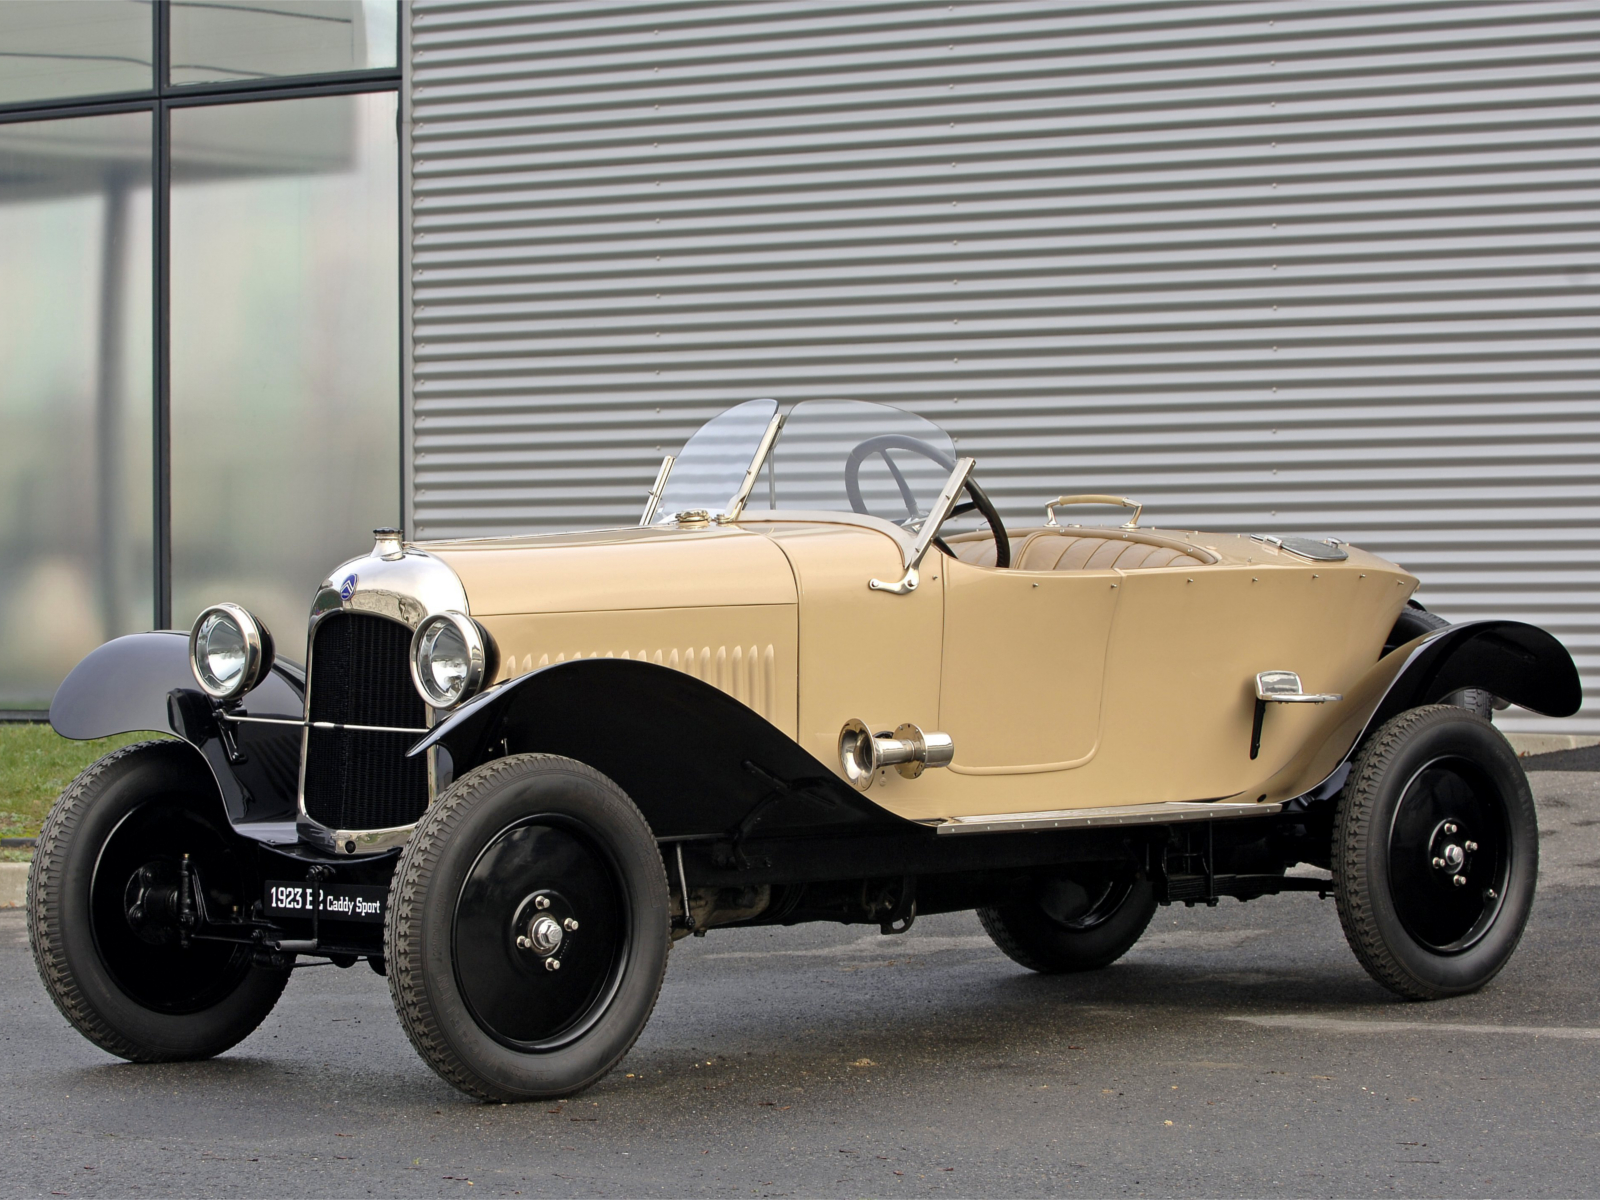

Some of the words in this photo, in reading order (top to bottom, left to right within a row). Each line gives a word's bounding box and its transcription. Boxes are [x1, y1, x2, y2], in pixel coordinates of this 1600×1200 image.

[270, 886, 303, 909] 1923
[326, 895, 355, 916] Caddy
[356, 897, 381, 917] Sport
[436, 973, 499, 1072] MICHELIN
